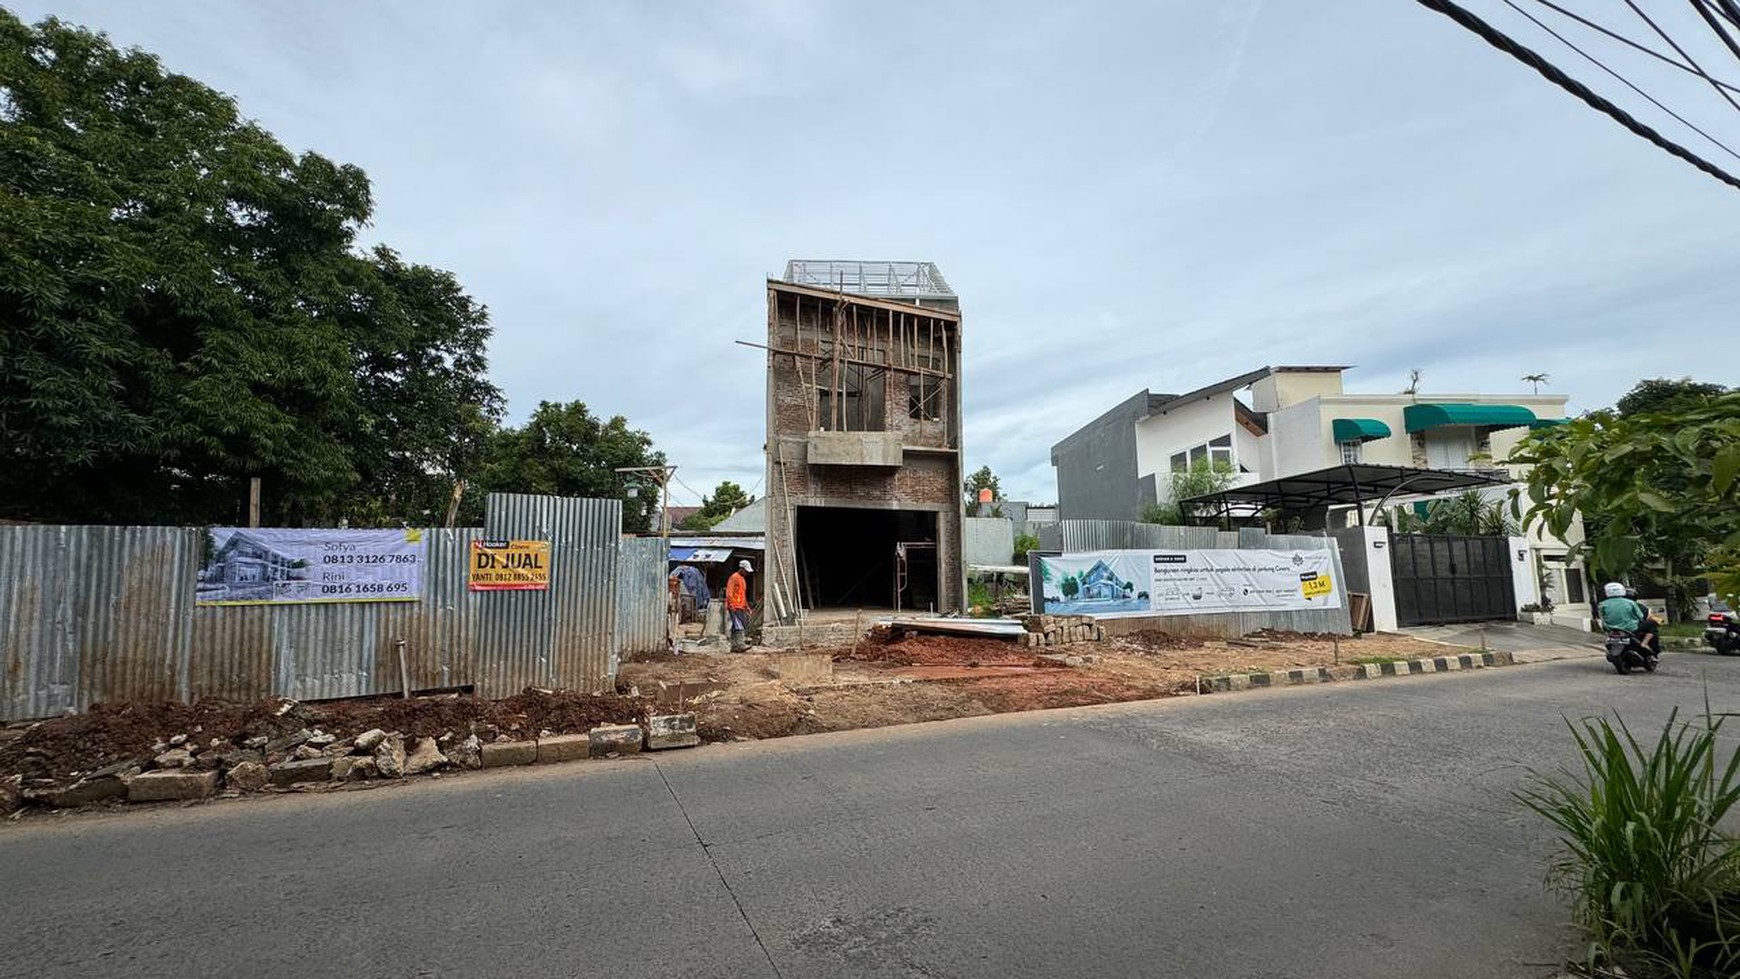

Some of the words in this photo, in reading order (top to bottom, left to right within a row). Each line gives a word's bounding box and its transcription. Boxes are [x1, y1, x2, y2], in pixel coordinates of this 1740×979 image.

[324, 542, 356, 552] Sofya
[323, 554, 354, 564] 0813
[357, 554, 386, 564] 3126
[388, 554, 417, 564] 7863
[477, 553, 497, 569] DI
[502, 553, 543, 569] JUAL
[323, 571, 345, 581] Rini
[471, 573, 492, 581] YANTI
[495, 573, 512, 581] 0812
[321, 584, 352, 594] 0816
[355, 584, 384, 594] 1658
[386, 583, 408, 593] 695
